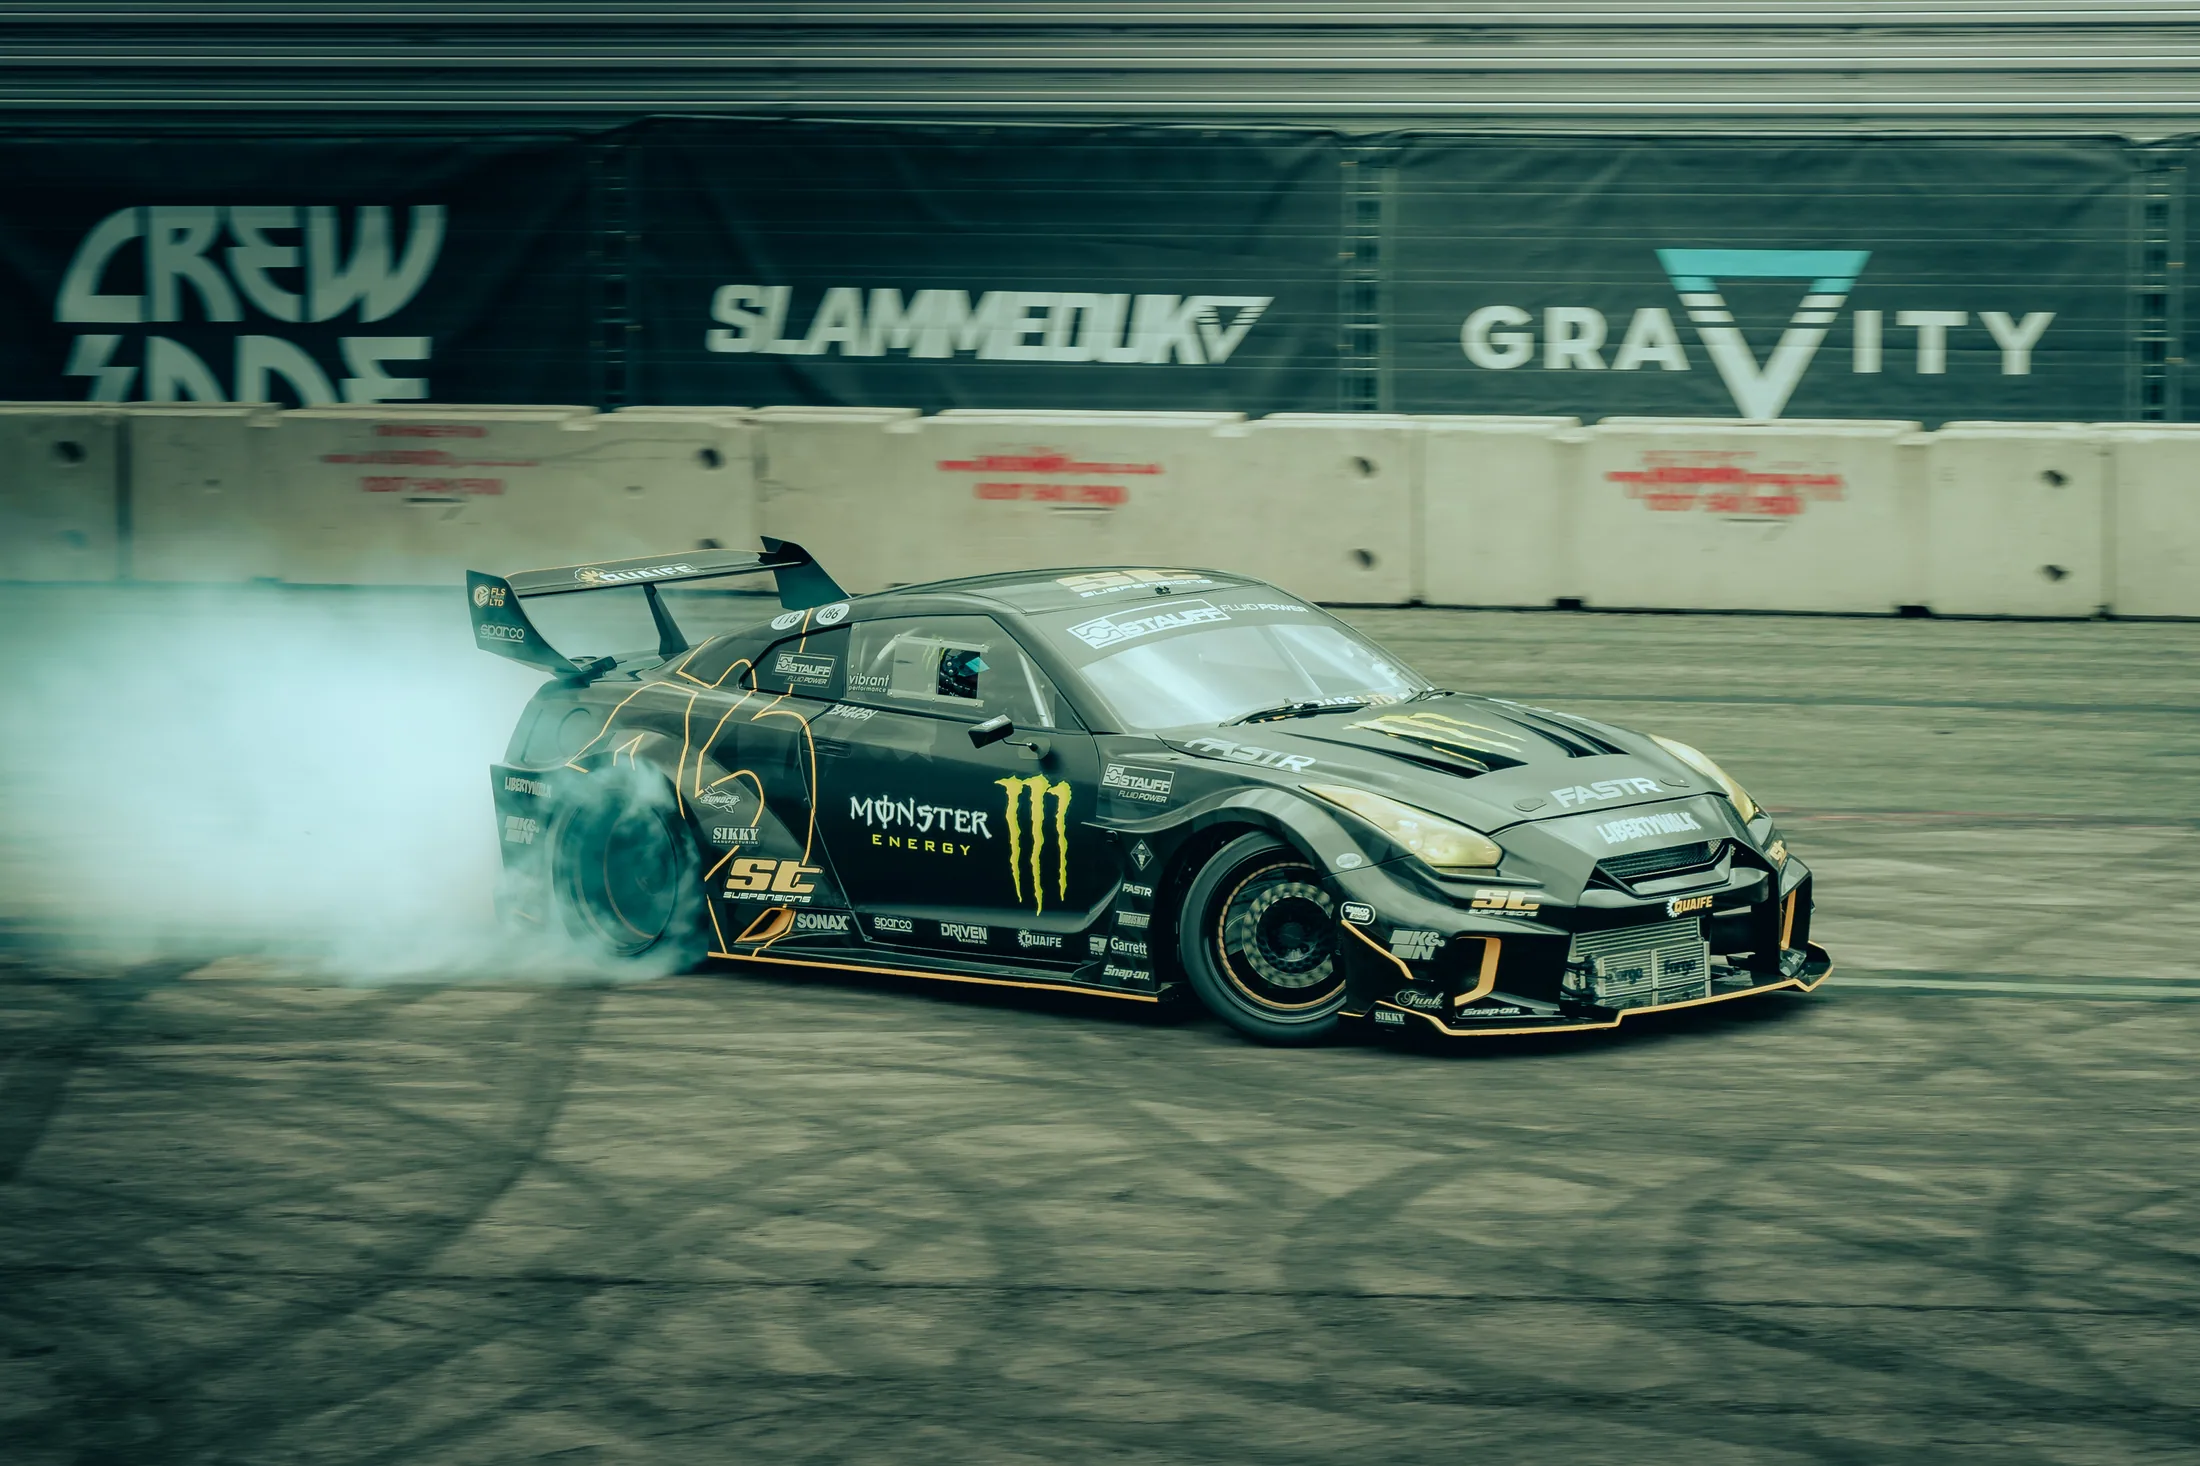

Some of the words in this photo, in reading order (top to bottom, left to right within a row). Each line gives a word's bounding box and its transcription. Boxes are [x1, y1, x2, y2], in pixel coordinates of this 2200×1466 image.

[54, 205, 447, 323] CREW
[1460, 249, 2057, 419] GRAVITY
[600, 565, 693, 581] QUAIFE
[491, 588, 506, 597] FLS
[489, 599, 504, 607] LTD
[821, 607, 841, 619] 186
[1117, 607, 1224, 637] STAUFF
[1220, 603, 1259, 613] FLUID
[1258, 603, 1309, 613] POWER
[480, 624, 525, 641] sparco
[790, 662, 831, 676] STAUFF
[787, 675, 805, 683] FLUID
[803, 676, 828, 685] POWER
[849, 673, 890, 687] vibrant
[848, 684, 887, 693] performance
[827, 704, 878, 721] BAGGSY
[1184, 738, 1317, 773] FASTR
[1121, 775, 1171, 791] STAUFF
[1118, 790, 1138, 799] FLUID
[1138, 792, 1167, 803] POWER
[1550, 777, 1665, 808] FASTR
[850, 795, 992, 839] MONSTER
[713, 827, 759, 840] SIKKY
[1596, 811, 1702, 844] LIBERTYWALK
[872, 834, 970, 856] ENERGY
[723, 891, 812, 903] SUSPENSIONS
[1122, 883, 1153, 897] FASTR
[1674, 895, 1714, 913] QUAIFE
[797, 913, 849, 930] SONAX
[874, 916, 912, 931] sparco
[941, 922, 988, 942] DRIVEN
[1025, 934, 1062, 948] QUAIFE
[1110, 937, 1148, 956] Garrett
[1395, 990, 1444, 1006] Funk
[1375, 1011, 1405, 1022] SIKKY
